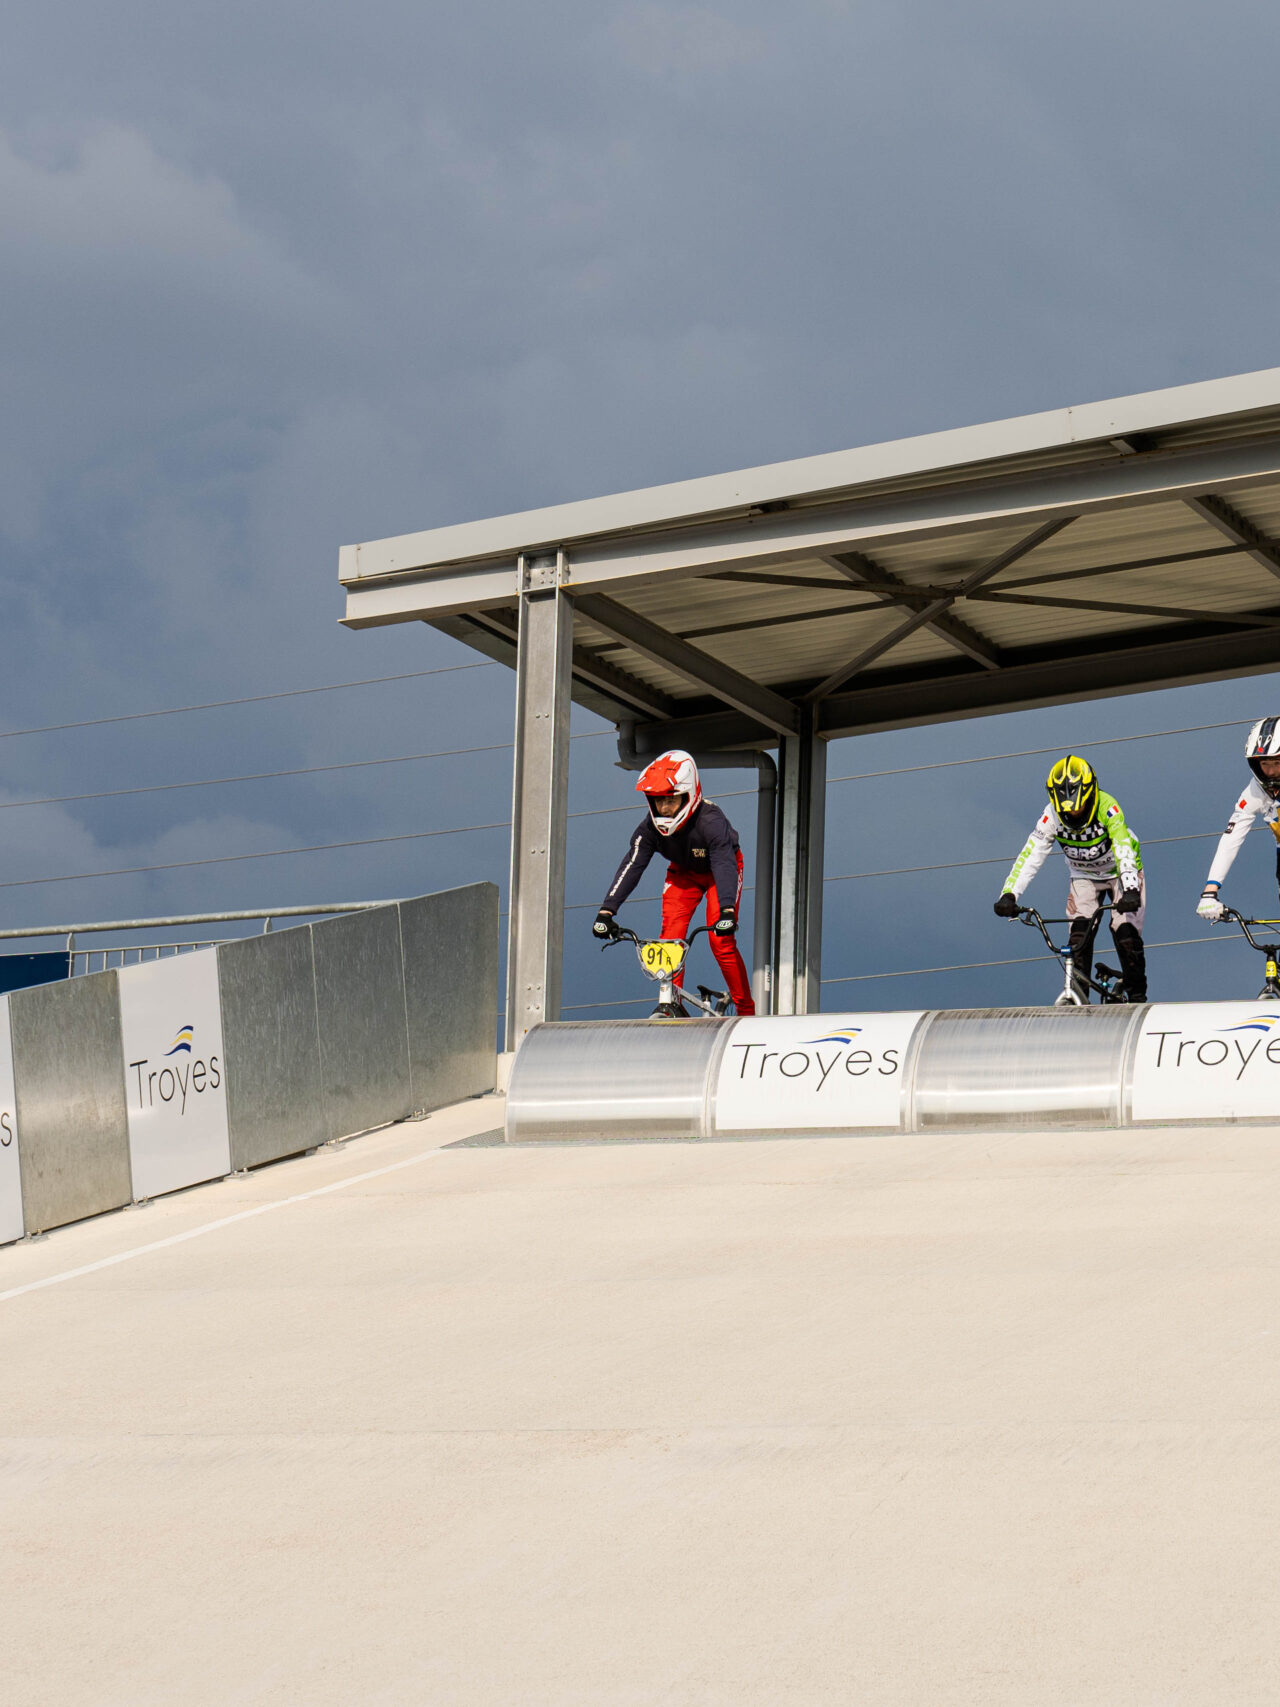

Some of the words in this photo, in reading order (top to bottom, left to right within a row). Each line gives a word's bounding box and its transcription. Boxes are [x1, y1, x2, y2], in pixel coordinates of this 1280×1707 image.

[646, 948, 664, 966] 91
[129, 1055, 221, 1115] Troyes
[732, 1043, 899, 1092] Troyes
